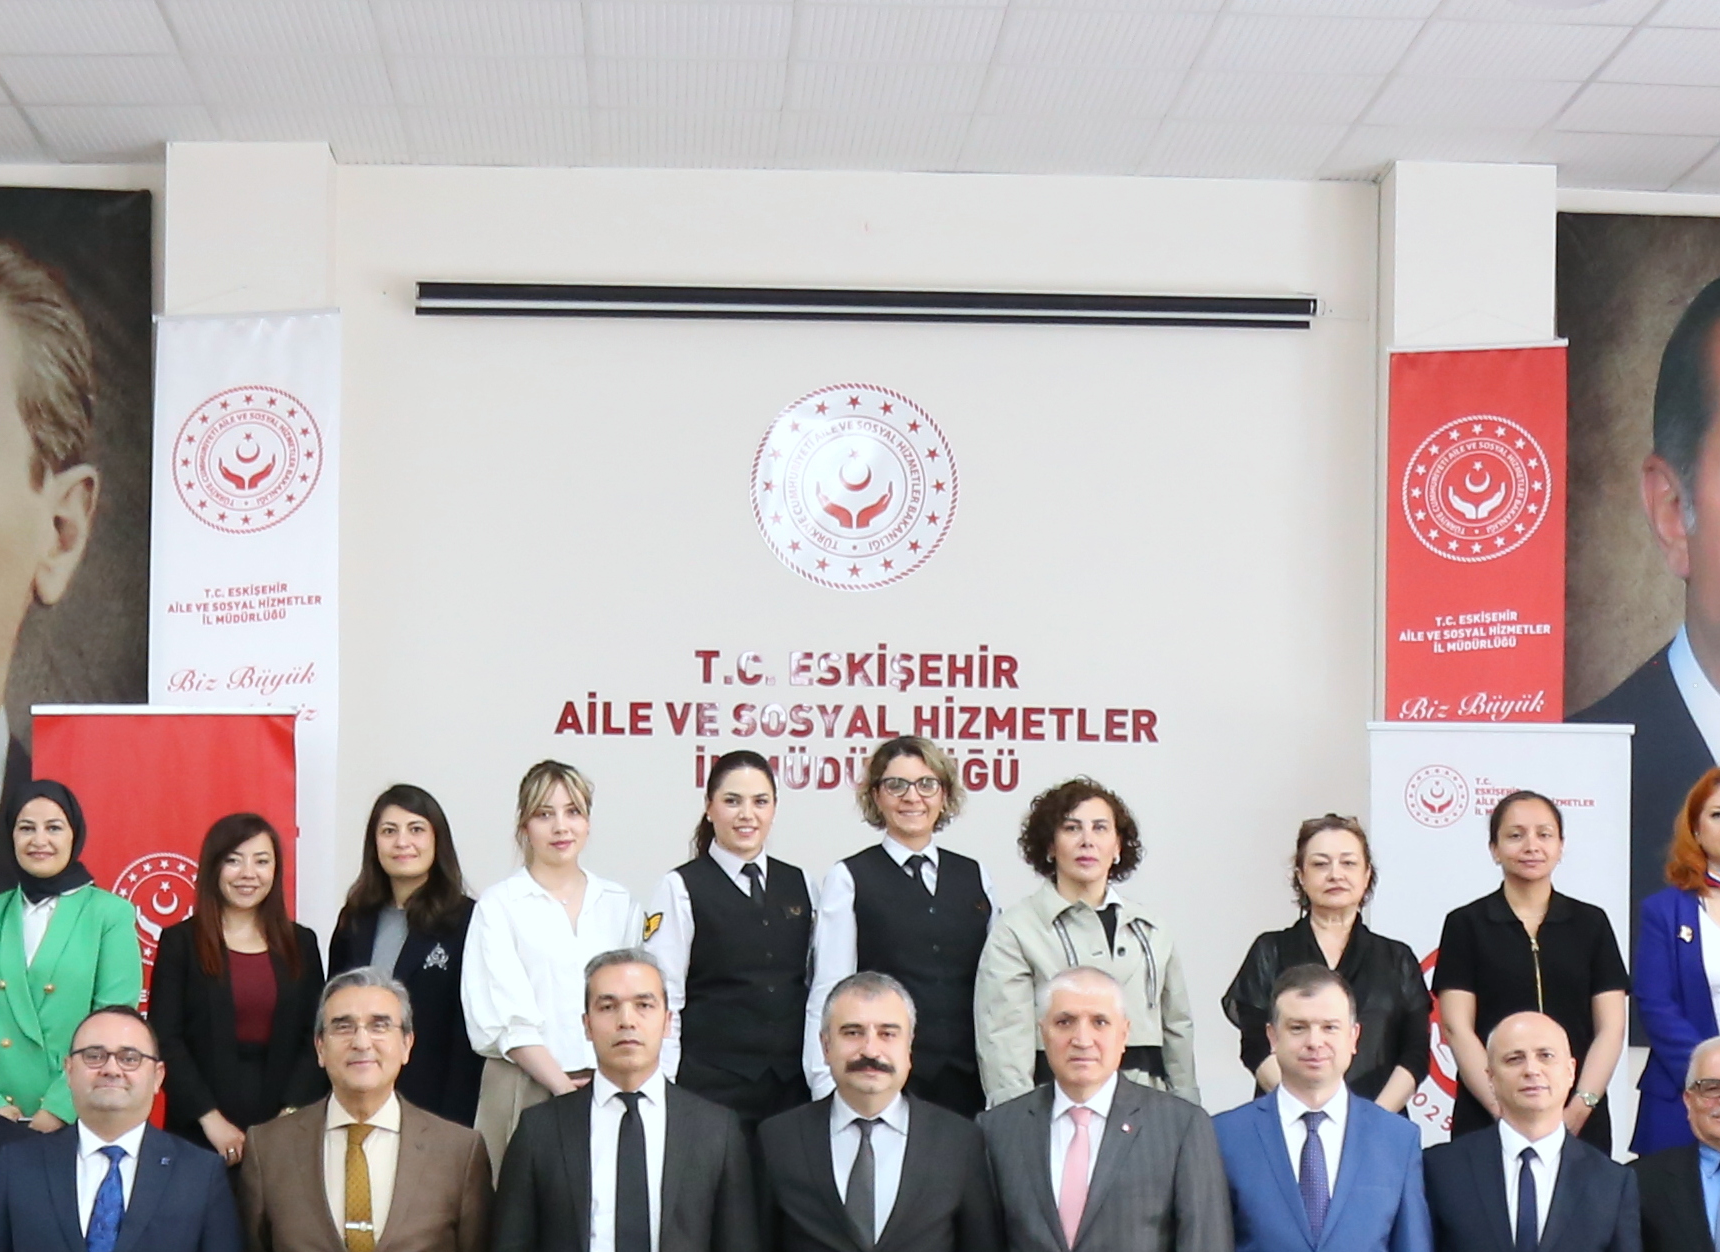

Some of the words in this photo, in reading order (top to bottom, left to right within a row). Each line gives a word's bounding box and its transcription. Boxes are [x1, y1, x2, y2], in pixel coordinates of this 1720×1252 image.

[219, 416, 235, 429] AİLE
[236, 412, 248, 421] VE
[249, 412, 278, 428] SOSYAL
[838, 421, 854, 431] VE
[856, 421, 897, 444] SOSYAL
[1466, 442, 1477, 450] VE
[1478, 441, 1508, 457] SOSYAL
[896, 441, 921, 504] HİZMETLER
[798, 515, 839, 551] TÜRKİYE
[868, 504, 917, 551] BAKANLIĞI
[204, 588, 225, 598] T.C.
[228, 582, 288, 597] ESKİŞEHİR
[167, 601, 193, 613] AİLE
[195, 603, 209, 612] VE
[212, 599, 255, 612] SOSYAL
[258, 595, 322, 609] HİZMETLER
[202, 614, 213, 625] İL
[216, 609, 286, 624] MÜDÜRLÜĞÜ
[1435, 616, 1457, 627] T.C.
[1459, 609, 1518, 625] ESKİŞEHİR
[1399, 629, 1424, 642] AİLE
[1427, 631, 1441, 641] VE
[1443, 627, 1487, 640] SOSYAL
[1489, 623, 1551, 636] HİZMETLER
[1433, 642, 1445, 653] İL
[1447, 636, 1517, 652] MÜDÜRLÜĞÜ
[695, 650, 776, 685] T.C.
[789, 643, 1019, 692] ESKİŞEHİR
[167, 669, 218, 693] Biz
[226, 662, 317, 696] Büyük
[1399, 696, 1450, 720] Biz
[1457, 690, 1545, 721] Büyük
[554, 692, 653, 735] AİLE
[665, 702, 720, 736] VE
[731, 702, 900, 739] SOSYAL
[913, 696, 1158, 743] HİZMETLER
[768, 746, 1020, 792] ÜDÜĞÜ
[1475, 777, 1492, 785] T.C.
[1476, 797, 1495, 806] AİLE
[1552, 797, 1595, 807] İZMETLER
[1475, 807, 1484, 816] İL
[1412, 1092, 1454, 1132] 025
